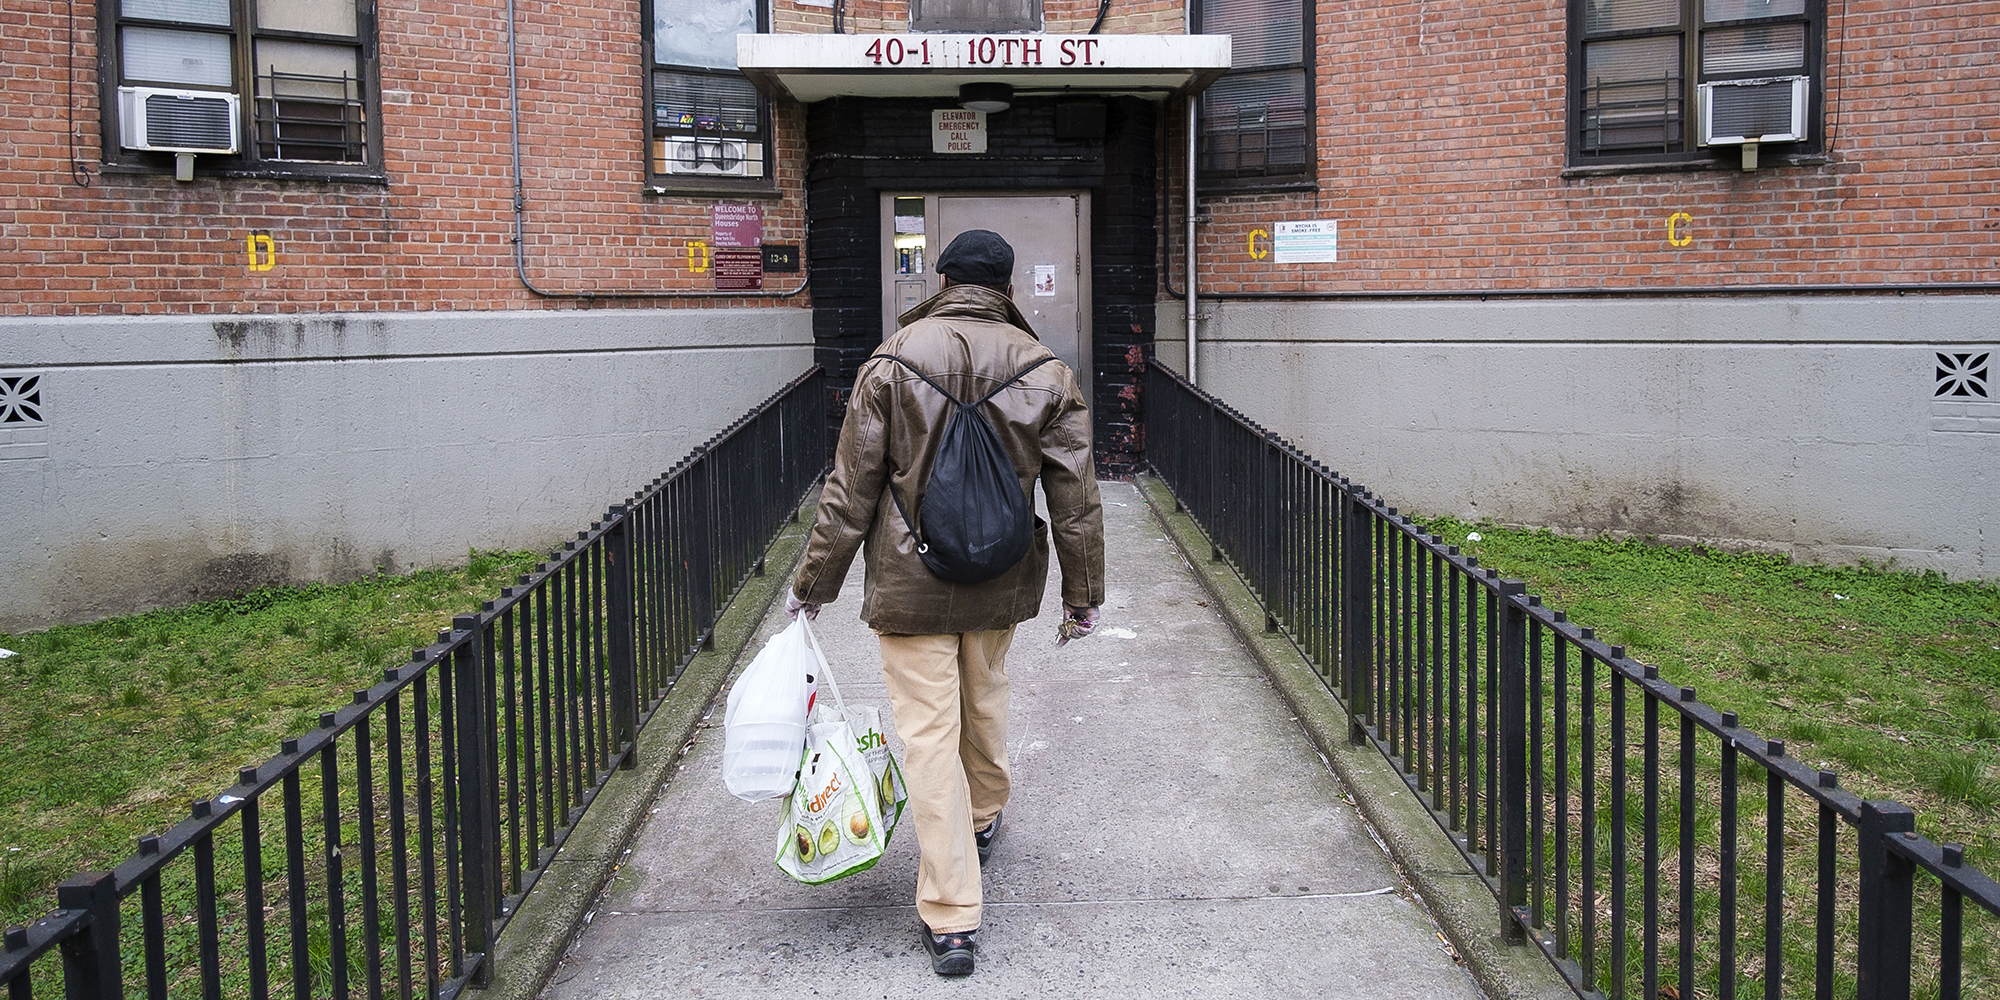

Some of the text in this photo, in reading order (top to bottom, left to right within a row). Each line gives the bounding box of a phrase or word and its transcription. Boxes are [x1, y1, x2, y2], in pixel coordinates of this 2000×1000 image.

[865, 37, 1106, 66] 40-1 10TH ST.
[942, 111, 976, 120] ELEVATOR
[938, 121, 980, 131] EMERGENCY
[950, 132, 968, 141] CALL
[947, 142, 972, 151] POLICE
[714, 205, 756, 214] WELCOME TO
[714, 213, 745, 221] Queensbridge
[1668, 212, 1693, 247] C
[1249, 229, 1268, 259] C
[247, 234, 275, 271] D
[688, 241, 708, 273] D
[770, 254, 788, 263] 13-9
